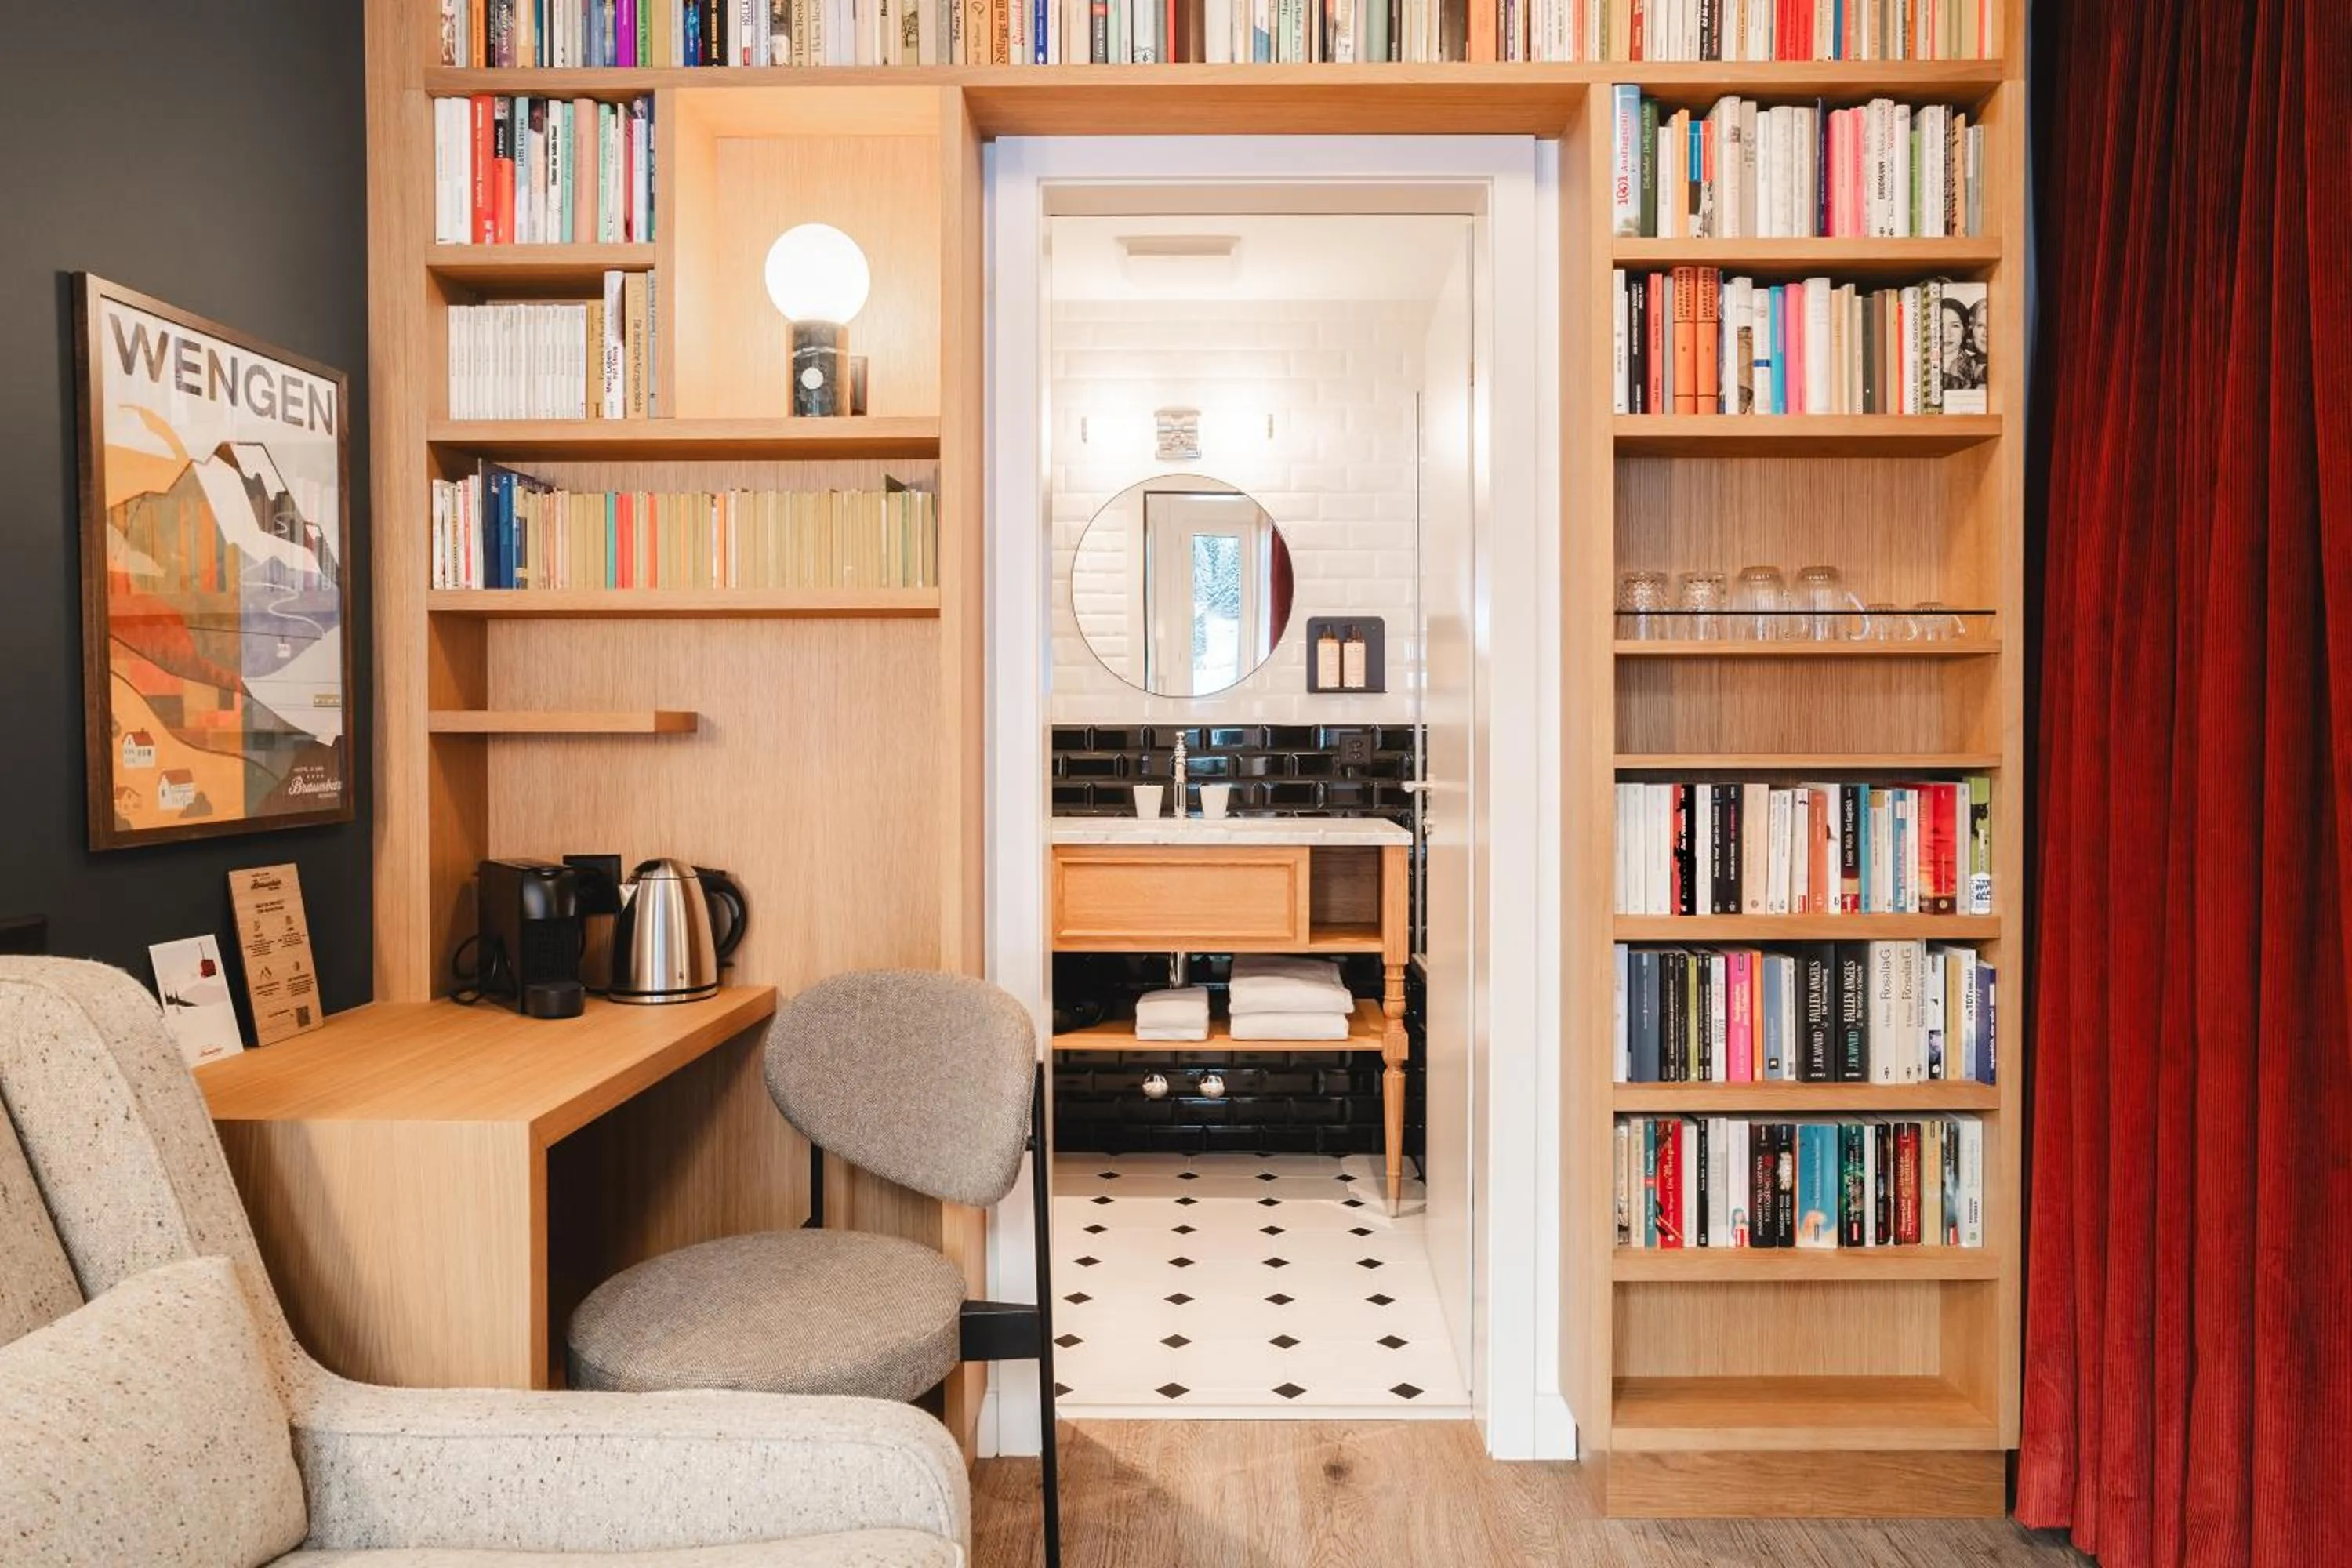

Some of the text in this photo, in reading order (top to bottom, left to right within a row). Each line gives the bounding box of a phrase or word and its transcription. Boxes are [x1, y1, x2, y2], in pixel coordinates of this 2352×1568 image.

[108, 313, 333, 435] WENGEN
[1809, 960, 1821, 1022] FALLEN ANGELS
[1844, 960, 1856, 1022] FALLEN ANGELS
[1880, 961, 1891, 1000] Rosalia
[1900, 960, 1911, 1000] Rosalia
